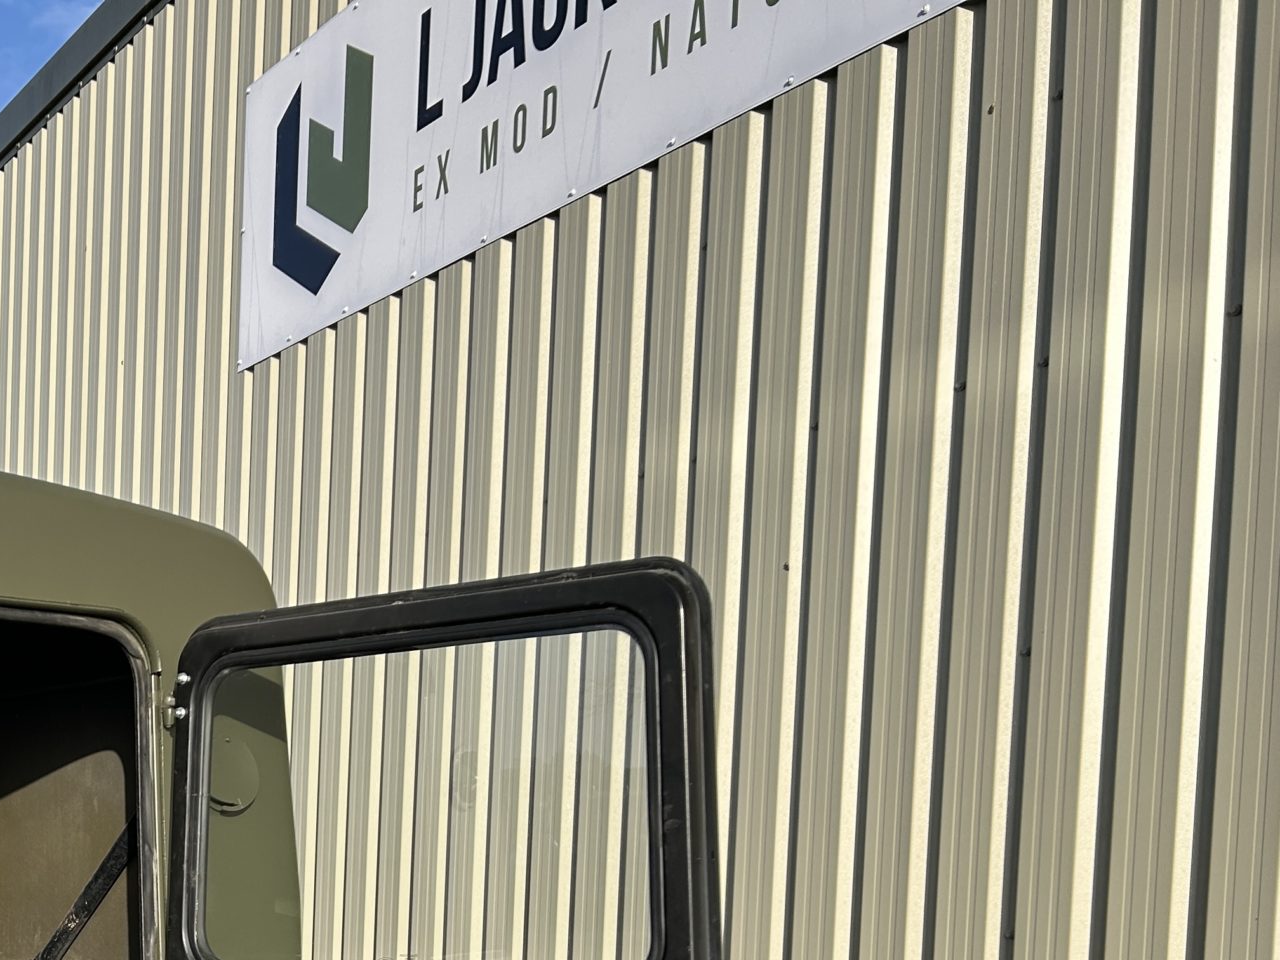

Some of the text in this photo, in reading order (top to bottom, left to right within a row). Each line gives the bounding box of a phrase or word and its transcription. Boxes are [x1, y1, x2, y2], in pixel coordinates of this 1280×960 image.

[413, 149, 451, 213] EX
[480, 85, 558, 175] MOD
[650, 0, 781, 76] NA
[461, 0, 618, 104] JA
